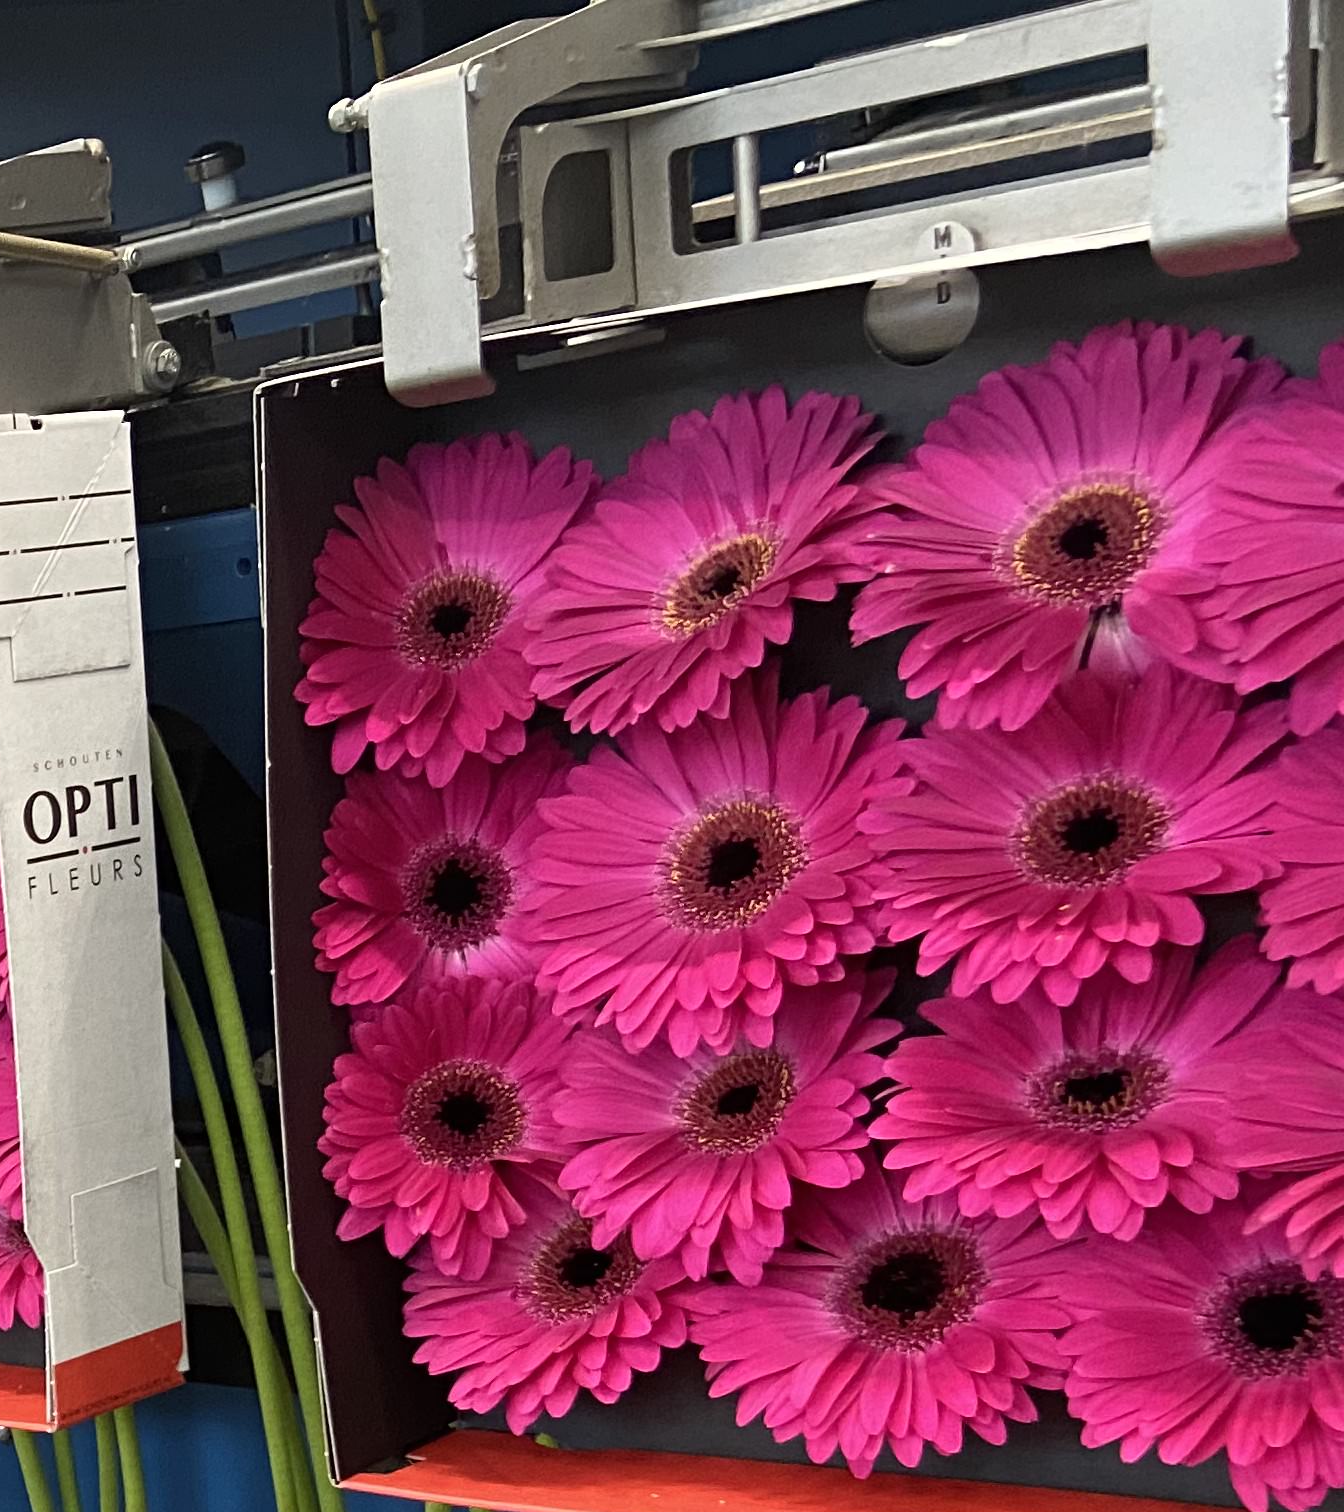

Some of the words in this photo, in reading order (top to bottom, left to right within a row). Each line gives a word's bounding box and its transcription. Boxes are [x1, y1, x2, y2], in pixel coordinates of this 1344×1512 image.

[33, 749, 124, 773] SCHOUTEN
[23, 774, 140, 844] OPTI
[28, 854, 143, 899] FLEURS
